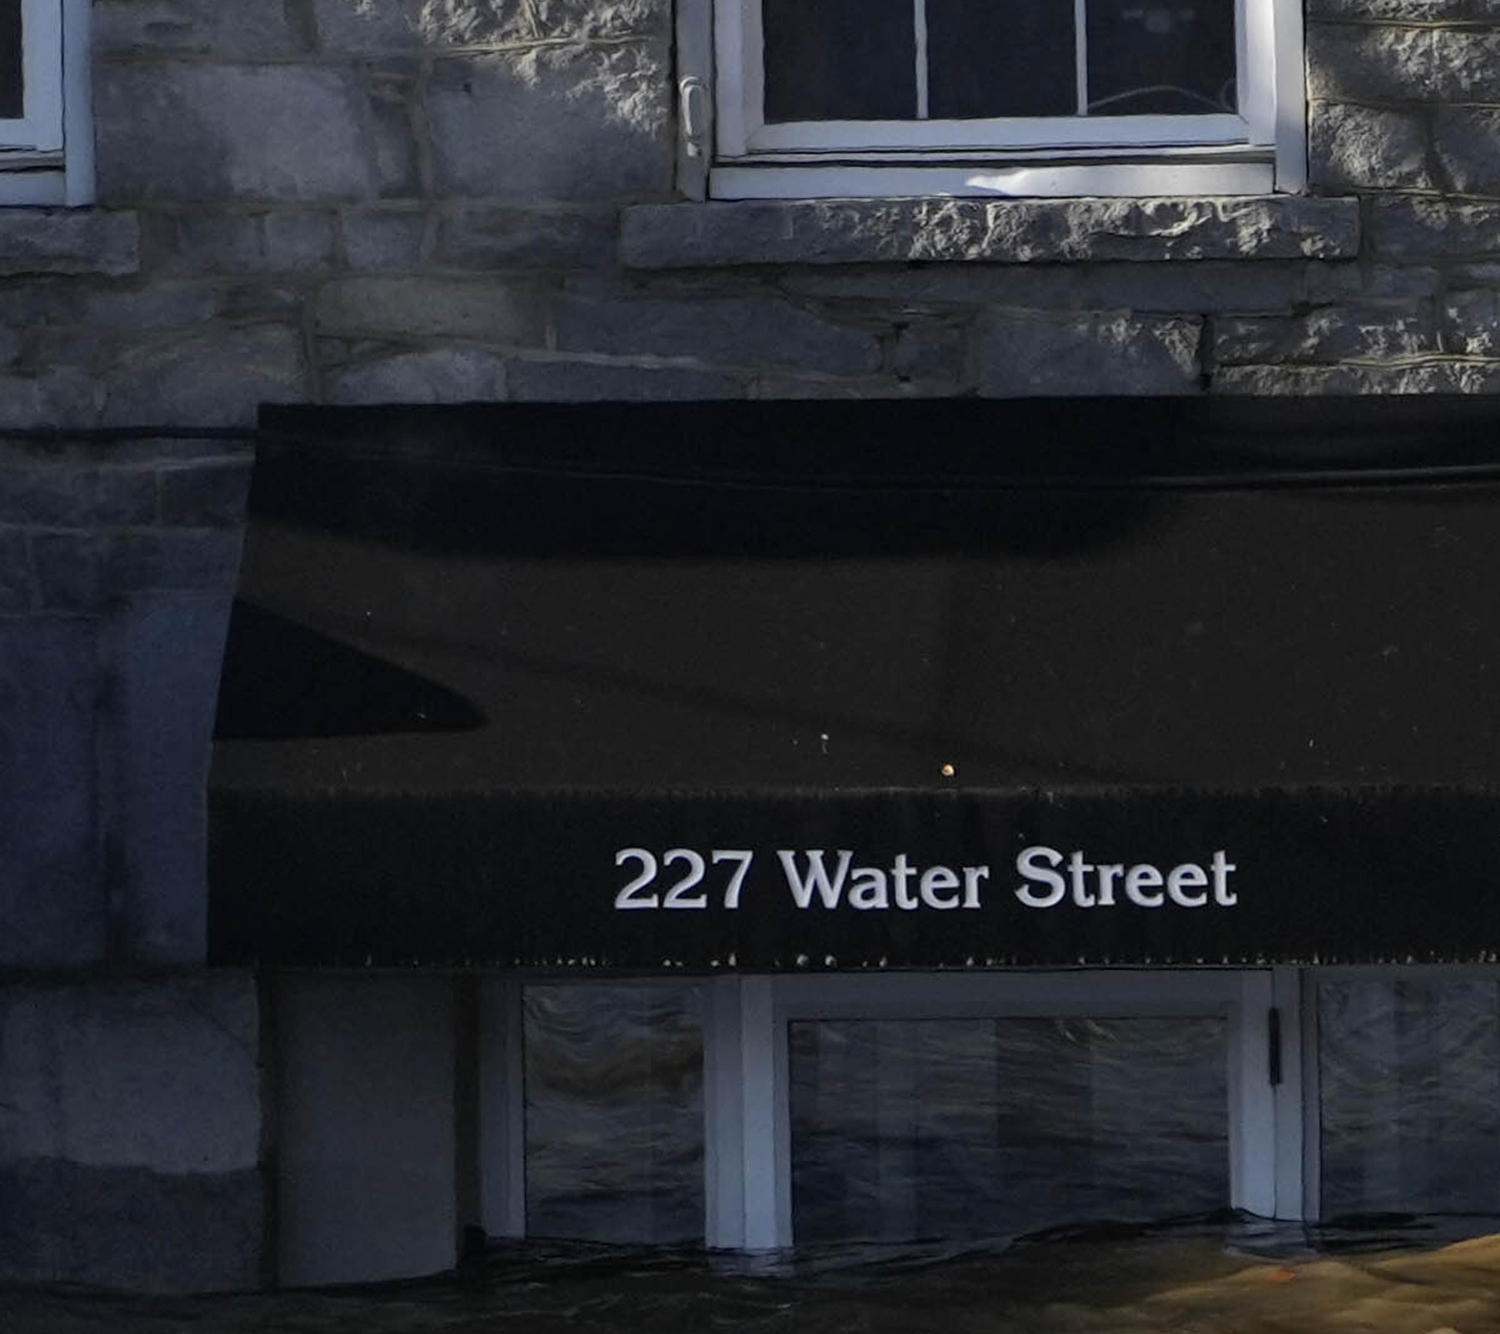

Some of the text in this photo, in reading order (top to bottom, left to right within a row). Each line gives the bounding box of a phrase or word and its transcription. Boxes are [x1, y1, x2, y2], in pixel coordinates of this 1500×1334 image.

[614, 845, 1238, 910] 227 Water Street
